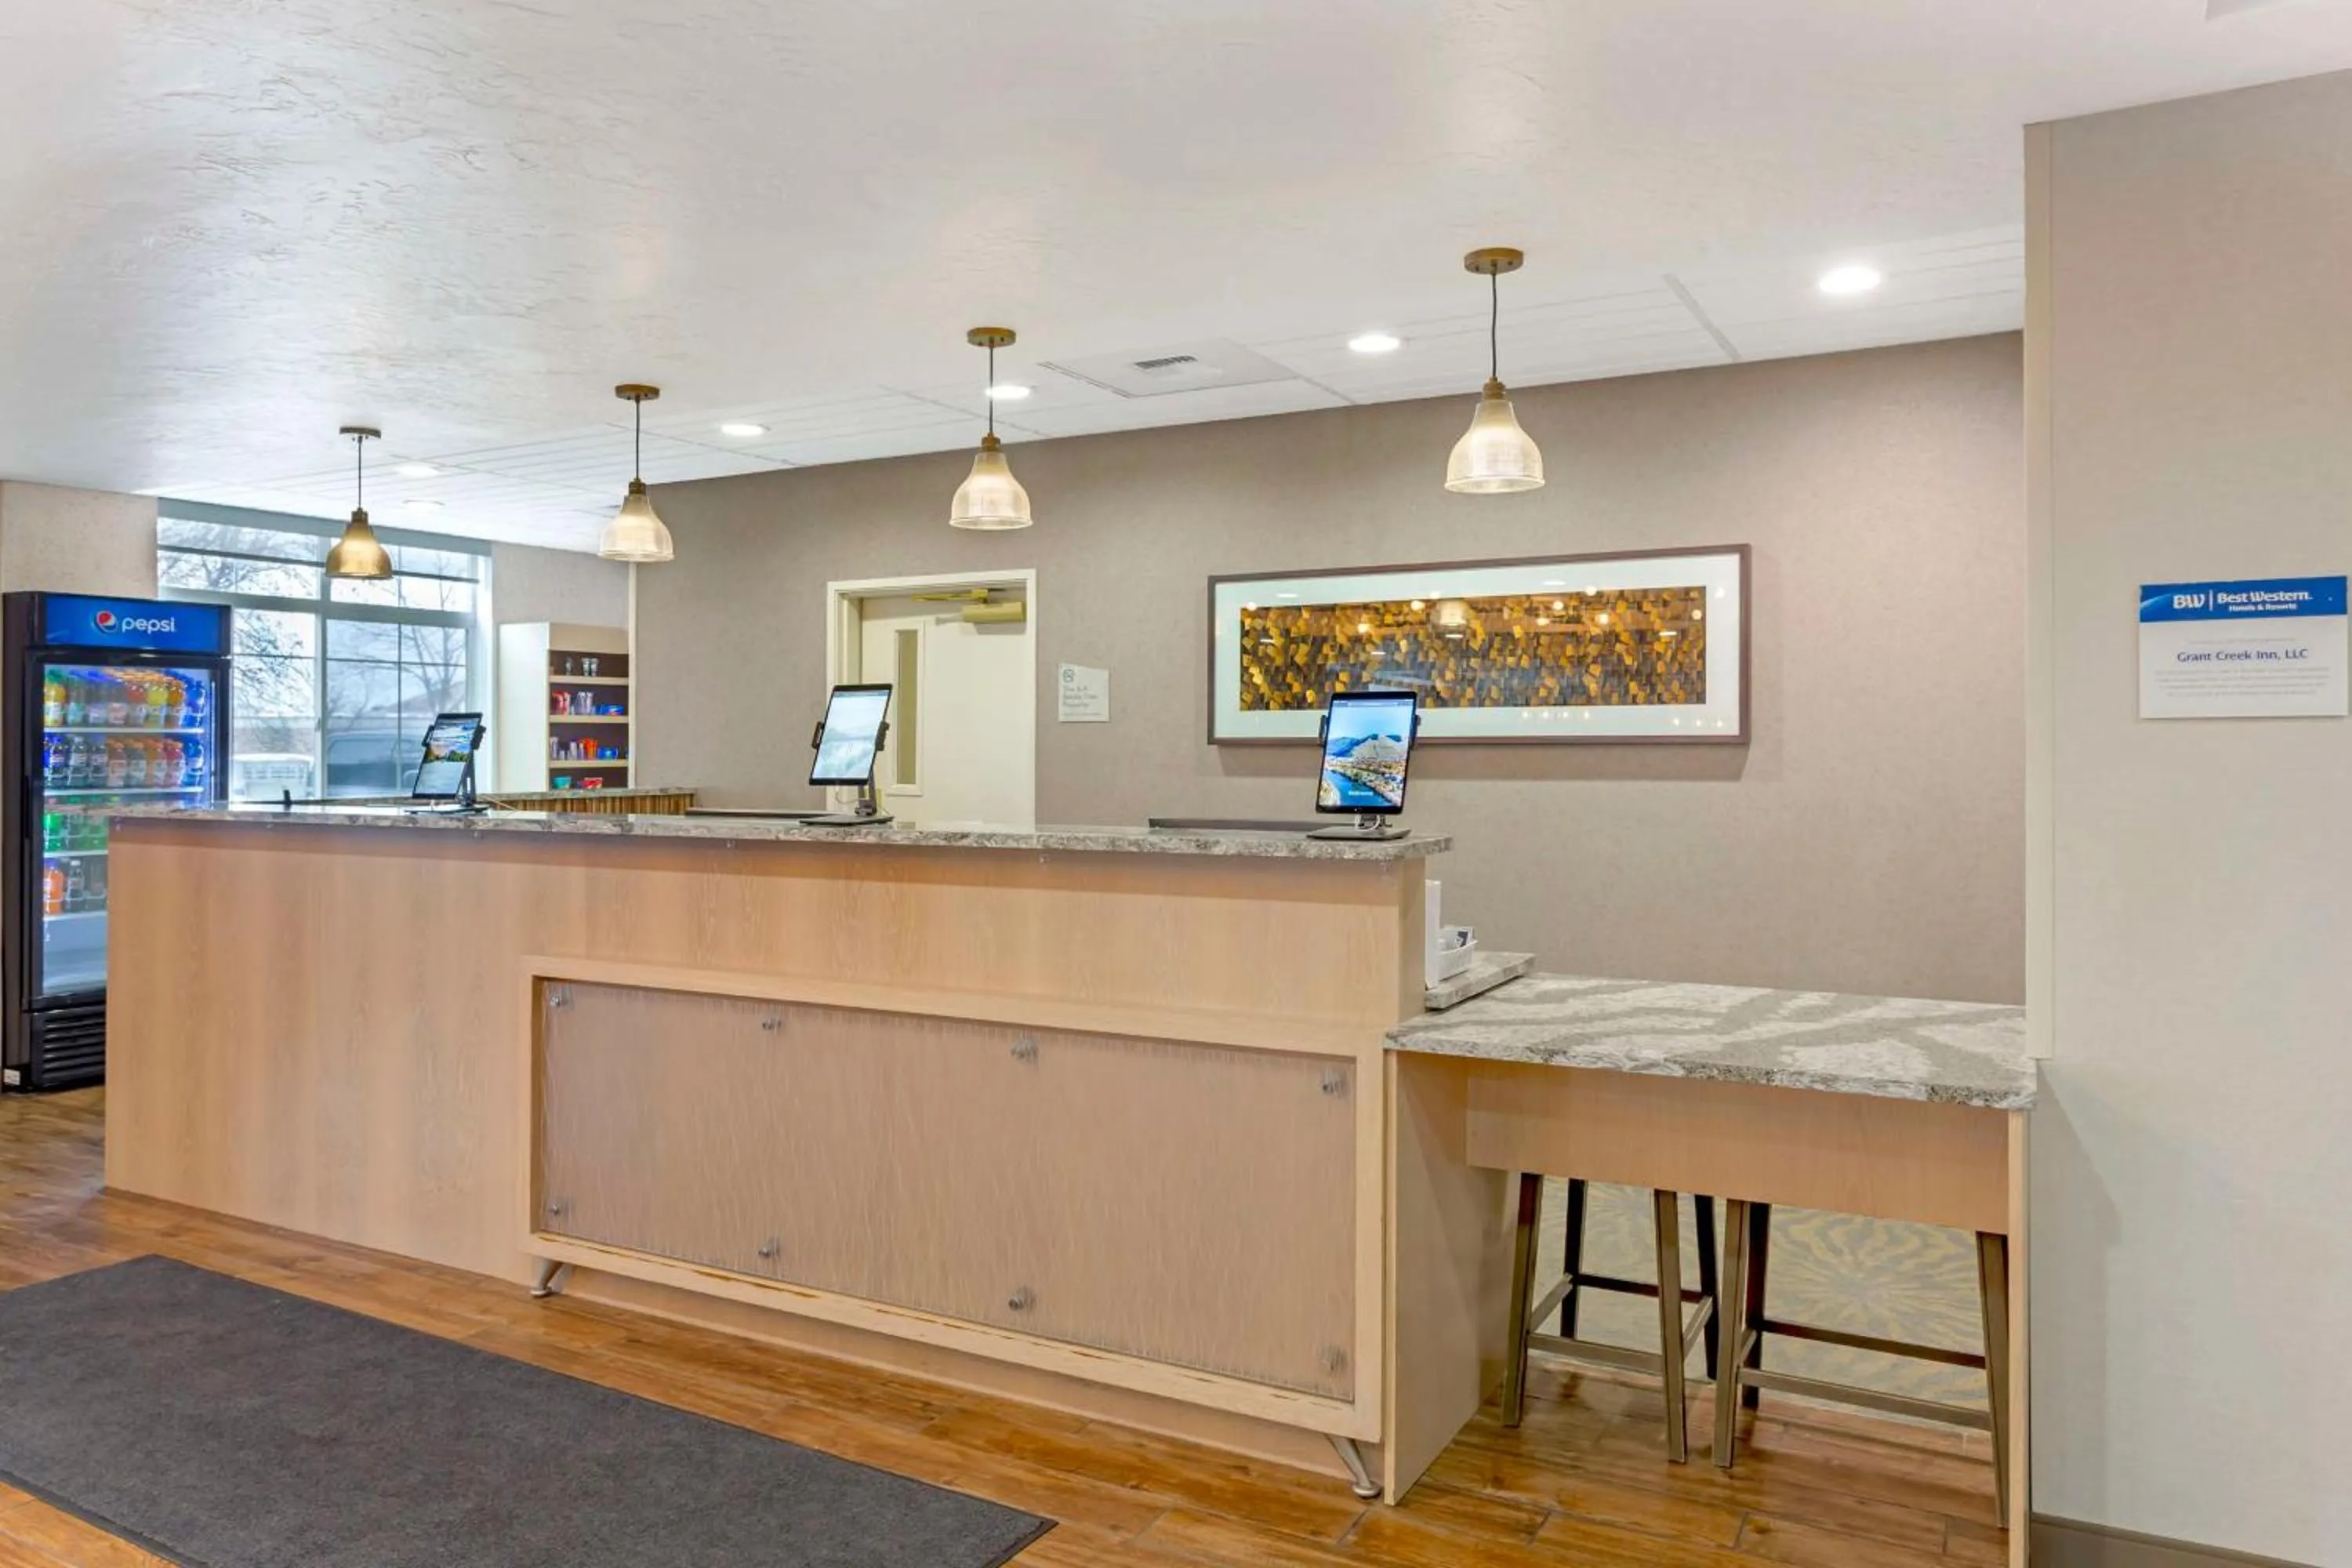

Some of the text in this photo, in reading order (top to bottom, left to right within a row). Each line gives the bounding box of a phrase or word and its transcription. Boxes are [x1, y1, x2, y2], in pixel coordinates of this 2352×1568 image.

[2173, 593, 2205, 609] BW
[2217, 592, 2249, 603] Best
[122, 616, 176, 634] pepsi
[2177, 648, 2308, 662] Grant Creek Inn, LLC
